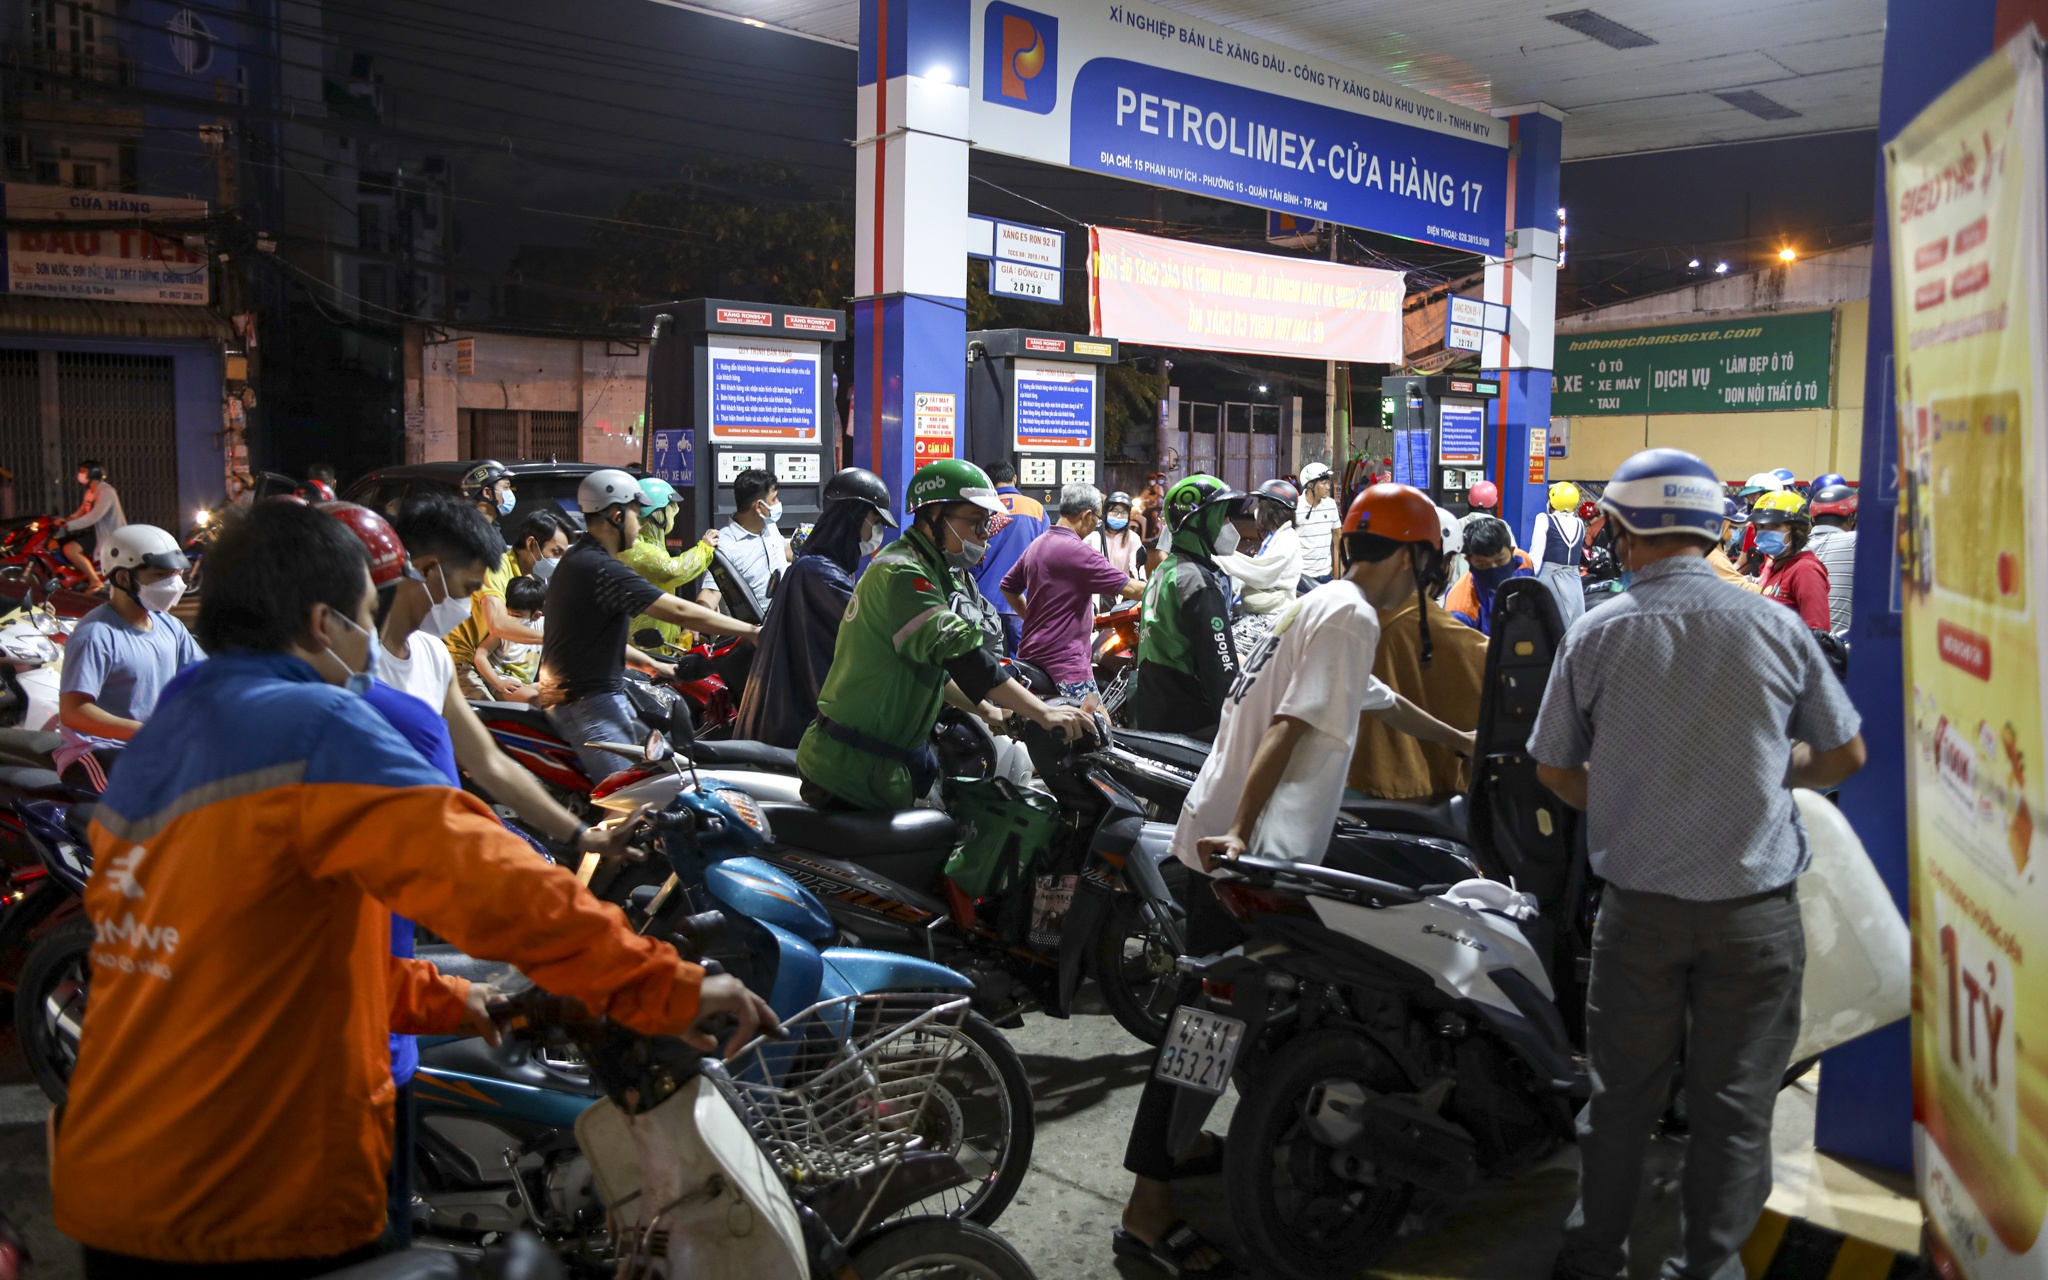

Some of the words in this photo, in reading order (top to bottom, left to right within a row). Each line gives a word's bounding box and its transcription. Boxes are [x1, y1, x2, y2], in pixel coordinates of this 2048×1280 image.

[1110, 5, 1122, 23] XÍ
[1126, 12, 1176, 39] NGHIỆP
[1180, 28, 1204, 48] BÁN
[1226, 43, 1259, 65] XĂNG
[1262, 54, 1285, 73] DẦU
[1294, 64, 1324, 86] CÔNG
[1328, 76, 1340, 90] TY
[1342, 80, 1370, 100] XĂNG
[1373, 90, 1392, 106] DẦU
[1395, 98, 1414, 114] KHU
[1416, 105, 1434, 121] VỰC
[1436, 112, 1442, 123] II
[1449, 114, 1471, 132] TNHH
[1473, 124, 1490, 138] MTV
[1100, 152, 1114, 166] ĐỊA
[1116, 154, 1132, 168] CHỈ:
[1134, 160, 1143, 170] 15
[1144, 161, 1166, 176] PHAN
[1168, 164, 1183, 180] HUY
[1184, 167, 1197, 182] ÍCH
[1202, 174, 1234, 192] PHƯỜNG
[1236, 182, 1244, 193] 15
[1248, 180, 1268, 200] QUẬN
[1269, 188, 1282, 202] TÂN
[1283, 191, 1299, 206] BÌNH
[1304, 198, 1312, 209] TP.
[1313, 200, 1328, 211] HCM
[1390, 157, 1454, 207] HÀNG
[1461, 180, 1482, 213] 17
[108, 198, 151, 213] HÀNG
[1002, 228, 1020, 240] XĂNG
[1030, 234, 1041, 245] RON
[1042, 237, 1050, 246] 92
[1426, 225, 1440, 238] ĐIỆN
[36, 262, 50, 274] SƠN
[1018, 266, 1038, 279] ĐỒNG
[1044, 272, 1054, 280] LÍT
[1014, 282, 1042, 294] 20730
[1598, 360, 1606, 372] Ô
[1610, 358, 1623, 372] TÔ
[1726, 354, 1746, 374] LÀM
[1749, 356, 1768, 376] ĐẸP
[1772, 352, 1778, 372] Ô
[1781, 351, 1794, 371] TÔ
[1563, 375, 1582, 392] XE
[1598, 380, 1612, 391] XE
[1616, 376, 1640, 390] MÁY
[1654, 369, 1688, 392] DỊCH
[1692, 368, 1710, 390] VỤ
[1724, 387, 1745, 406] DỌN
[1747, 382, 1765, 406] NỘI
[1768, 379, 1792, 402] THẤT
[1794, 381, 1802, 400] Ô
[1804, 380, 1818, 400] TÔ
[1597, 398, 1620, 409] TAXI
[928, 442, 940, 454] CẤM
[940, 442, 950, 454] LỬA
[914, 475, 946, 495] Grab
[1214, 632, 1234, 672] gojek
[1162, 1045, 1226, 1089] 353.21
